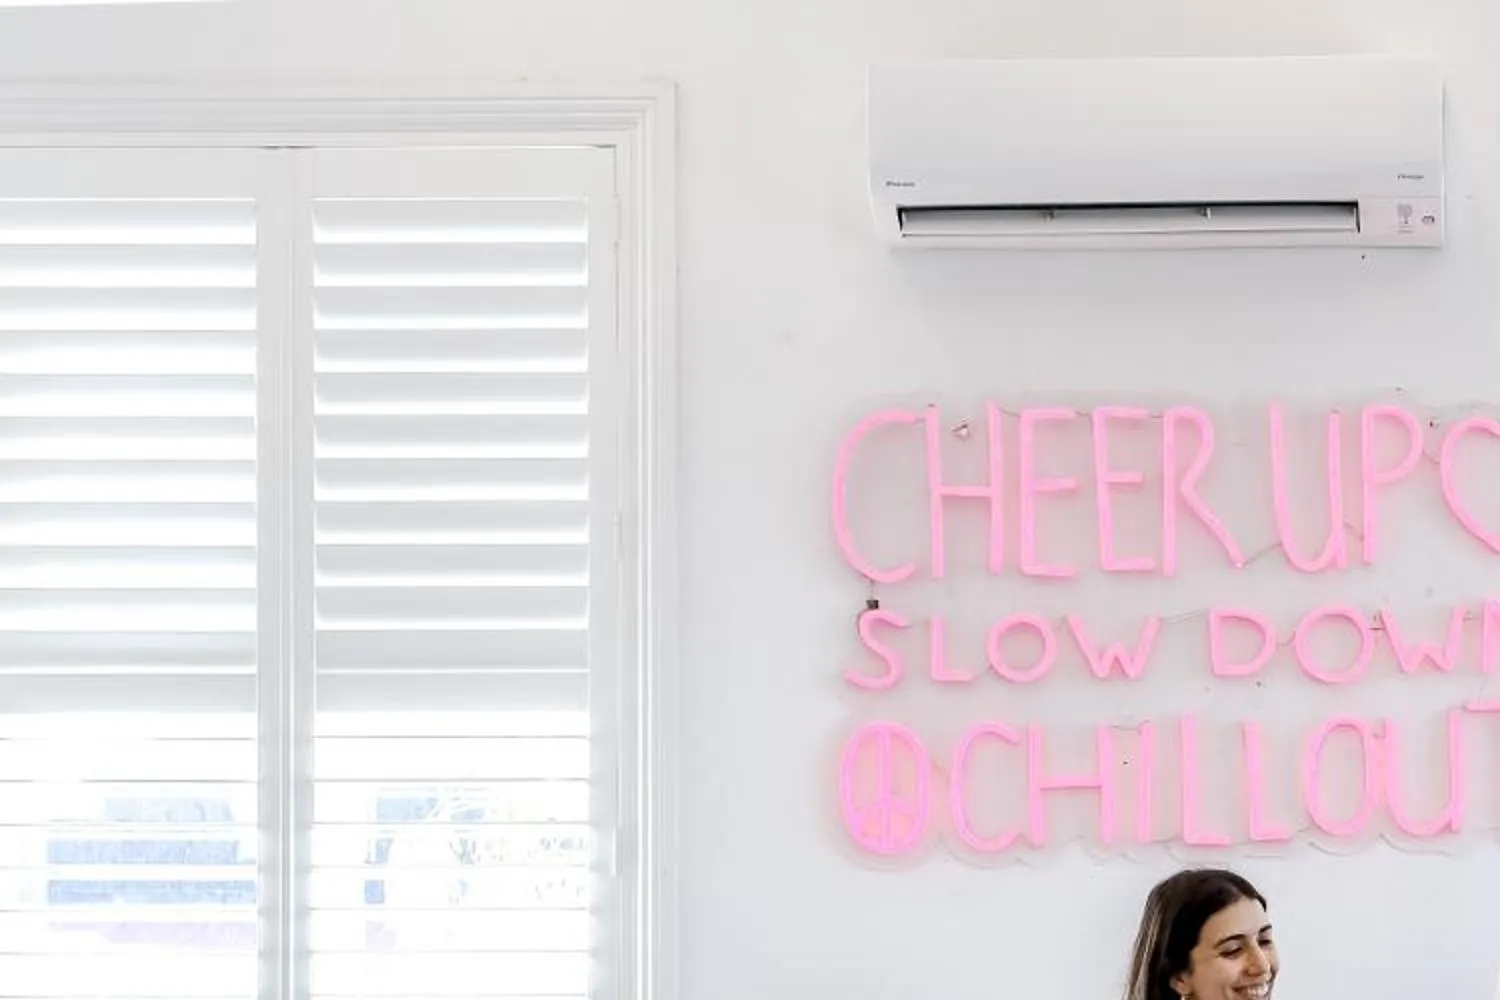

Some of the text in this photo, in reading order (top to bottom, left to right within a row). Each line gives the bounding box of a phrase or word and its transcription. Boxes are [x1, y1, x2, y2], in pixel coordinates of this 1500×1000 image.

[832, 401, 1425, 583] CHEER UP
[844, 608, 1163, 690] SLOW
